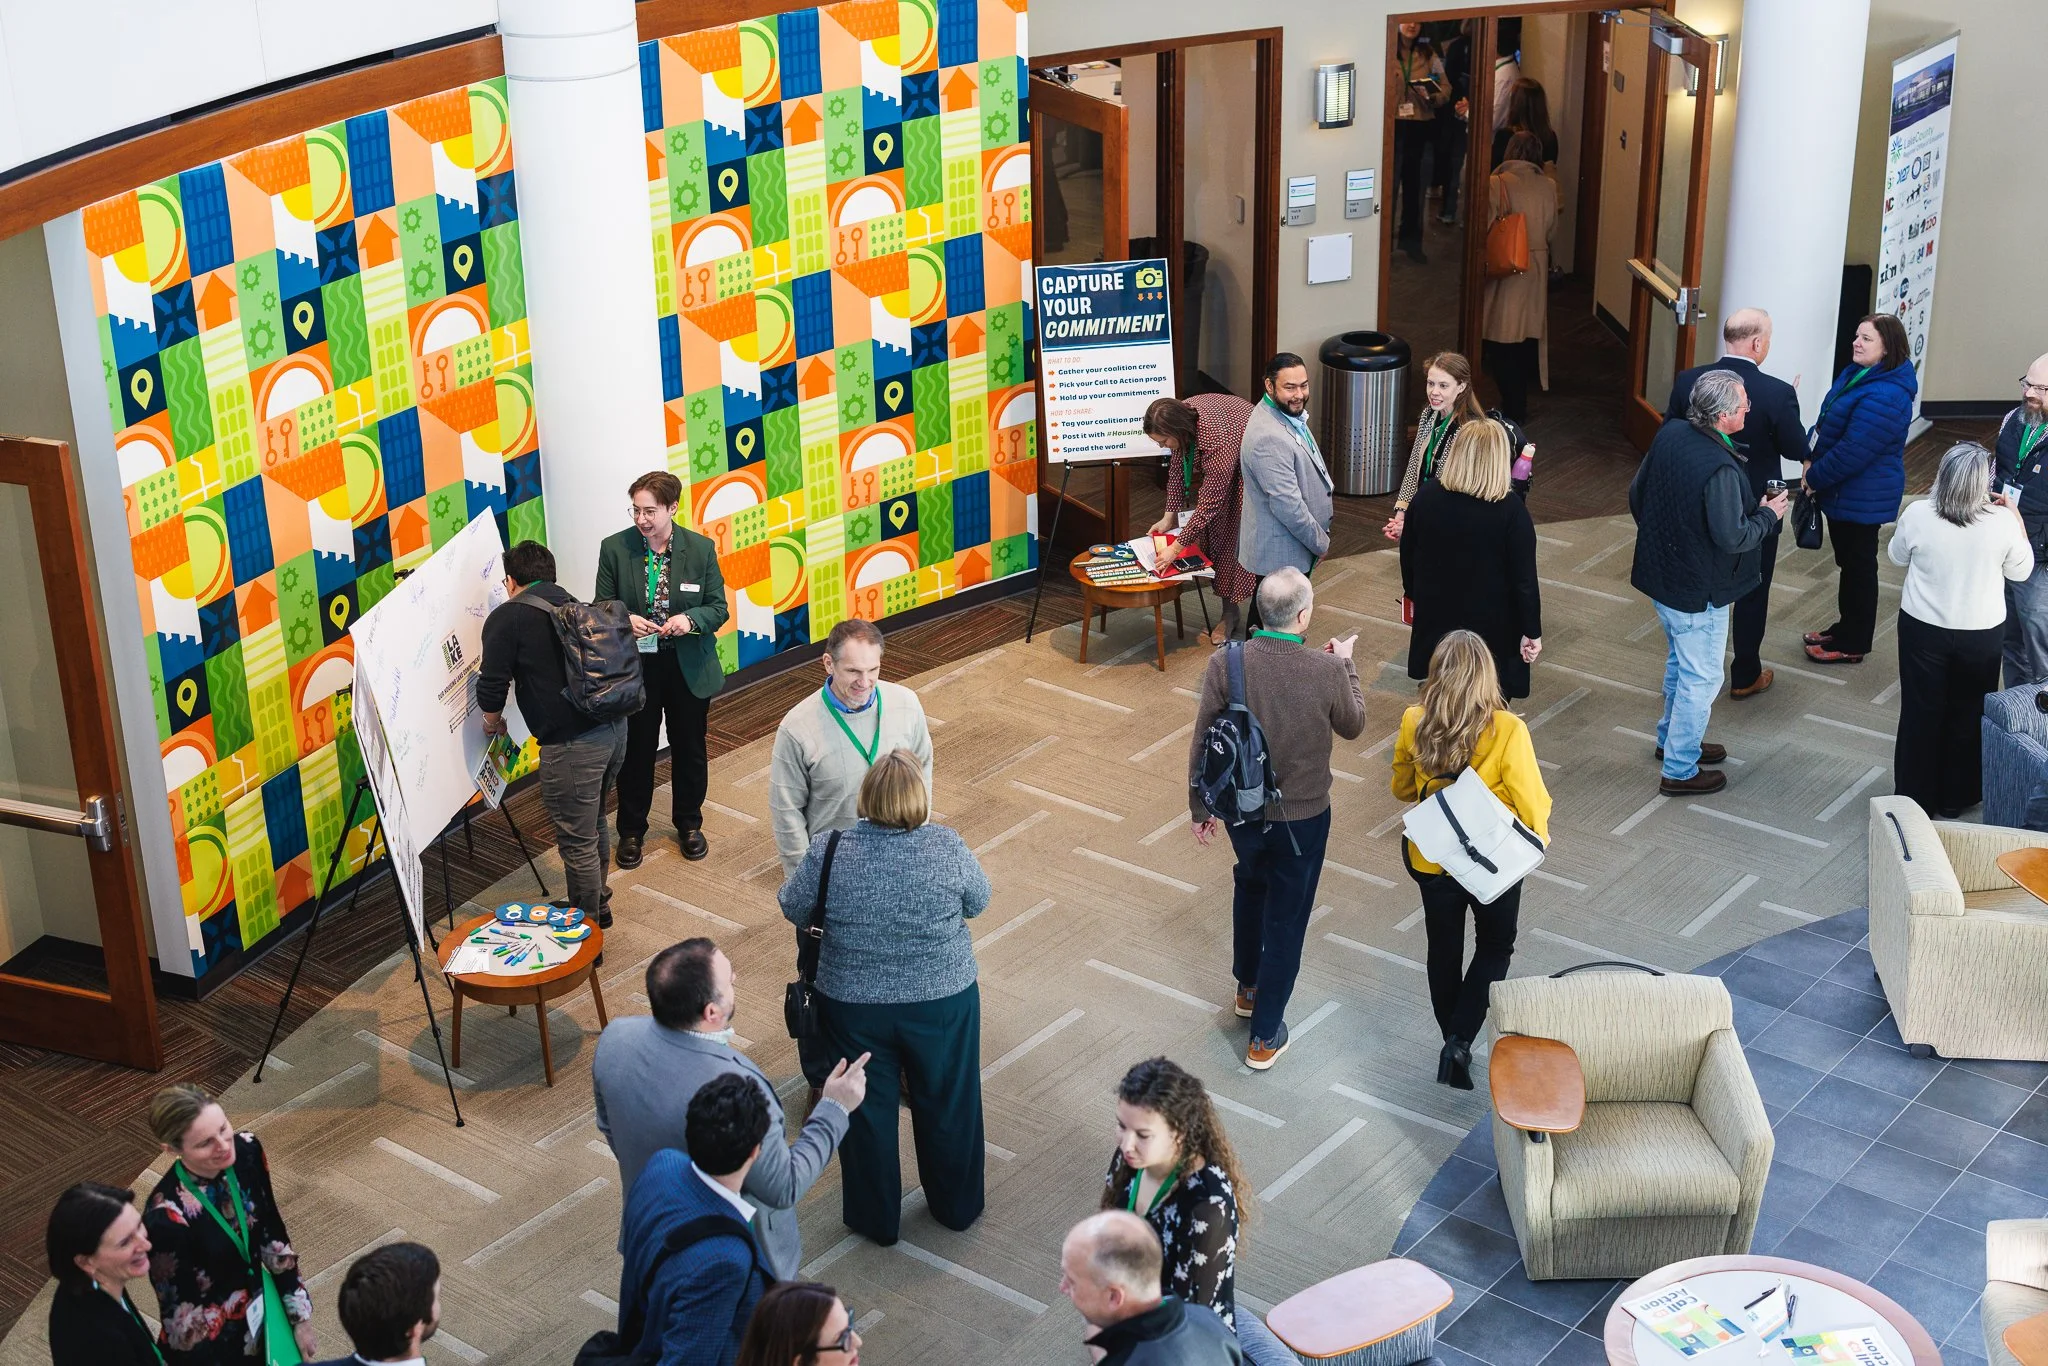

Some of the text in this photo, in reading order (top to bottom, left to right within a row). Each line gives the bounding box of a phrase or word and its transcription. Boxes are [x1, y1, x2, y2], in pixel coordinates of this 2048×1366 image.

[1042, 272, 1124, 295] CAPTURE
[1043, 297, 1092, 317] YOUR
[1045, 313, 1166, 339] COMMITMENT
[1047, 357, 1063, 365] WHAT
[1058, 367, 1084, 375] Gather
[1103, 364, 1137, 372] coalition
[1059, 380, 1075, 388] Pick
[1119, 377, 1144, 385] Action
[1059, 392, 1077, 401] Hold
[1089, 392, 1107, 400] your
[1107, 389, 1160, 398] commitments
[1050, 409, 1064, 417] HOW
[1061, 420, 1075, 428] Tag
[1076, 419, 1094, 427] your
[1094, 417, 1128, 425] coalition
[1063, 445, 1089, 454] Spread
[1105, 442, 1127, 450] word!
[446, 634, 459, 653] LA
[450, 645, 463, 665] KE
[484, 760, 496, 780] Call
[480, 769, 496, 797] Action
[1640, 1288, 1689, 1311] Action
[1667, 1296, 1698, 1313] Call
[1855, 1354, 1876, 1366] all
[1862, 1338, 1889, 1366] ction
